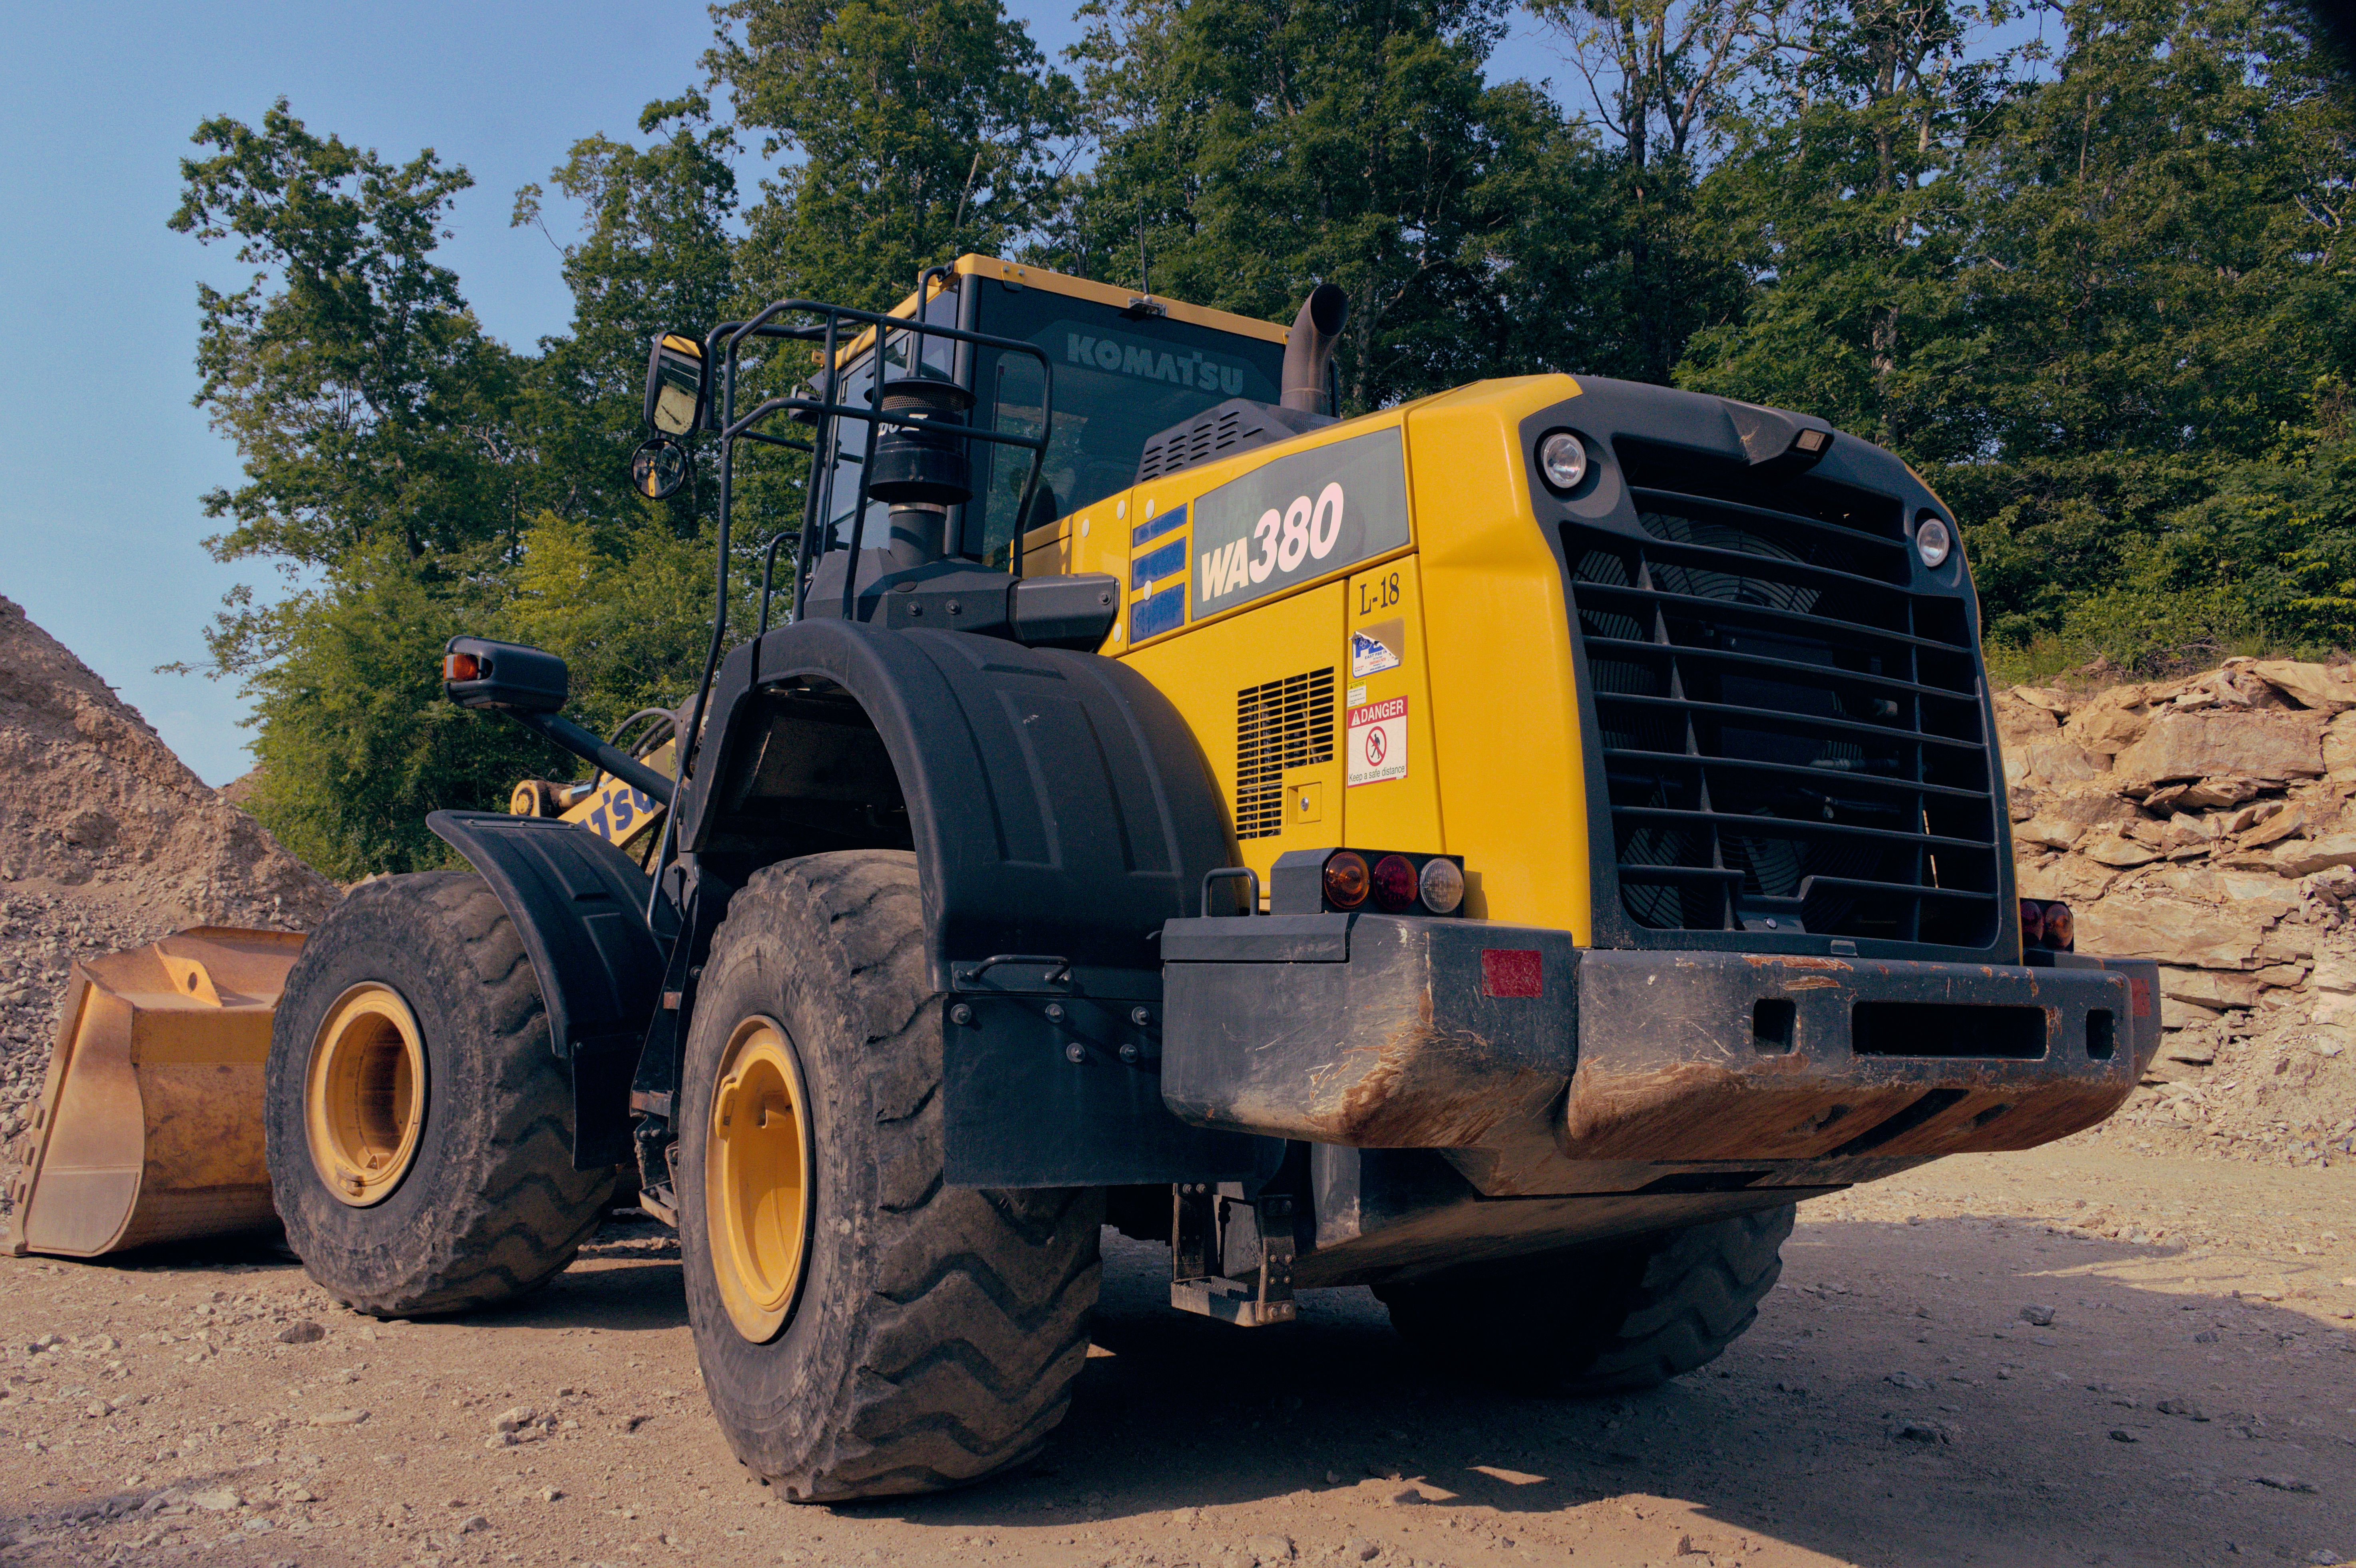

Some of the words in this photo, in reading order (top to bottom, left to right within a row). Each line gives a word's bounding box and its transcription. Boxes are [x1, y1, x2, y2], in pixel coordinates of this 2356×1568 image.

[1067, 333, 1243, 396] KOMATSU
[1202, 482, 1344, 602] WA380
[1359, 572, 1399, 616] L-18
[1361, 699, 1403, 723] DANGER
[1349, 773, 1363, 783] Keep
[1369, 768, 1380, 778] safe
[1382, 765, 1405, 776] distance
